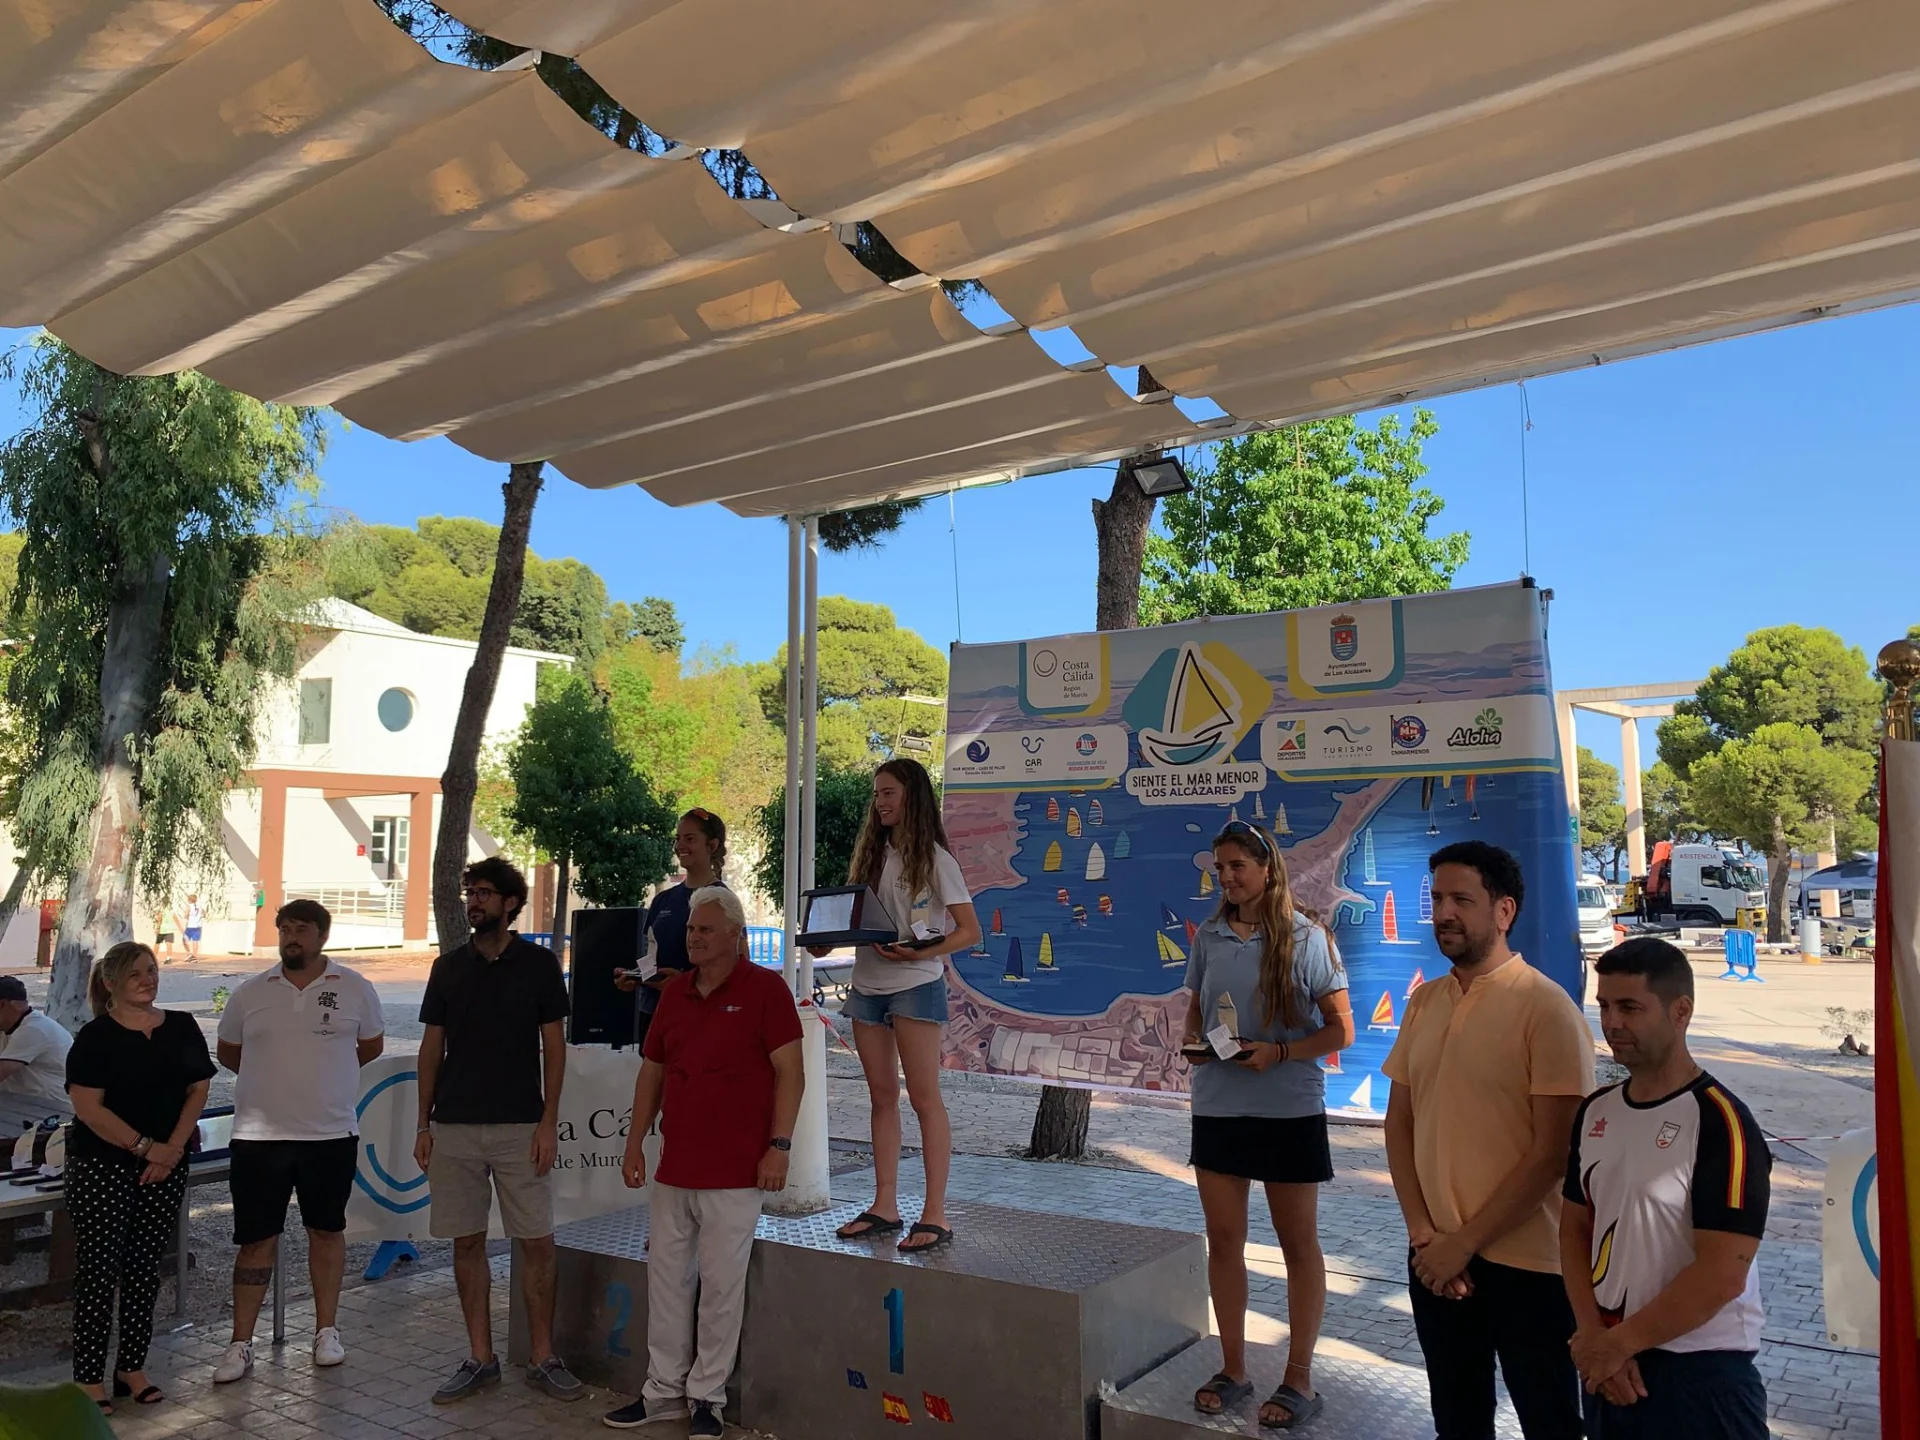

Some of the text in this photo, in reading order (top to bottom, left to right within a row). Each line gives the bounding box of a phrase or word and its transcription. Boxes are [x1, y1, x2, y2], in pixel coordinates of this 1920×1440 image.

[1062, 660, 1090, 671] Costa
[1328, 661, 1367, 670] Ayuntamiento
[1062, 670, 1094, 682] Cálida
[1447, 727, 1502, 747] Aloha
[1323, 745, 1373, 755] TURISMO
[1025, 758, 1042, 767] CAR
[1132, 771, 1259, 788] SIENTE EL MAR MENOR
[1145, 785, 1237, 797] LOS ALCÁZARES
[552, 1152, 624, 1169] de Murc
[605, 1281, 632, 1357] 2
[883, 1288, 904, 1374] 1
